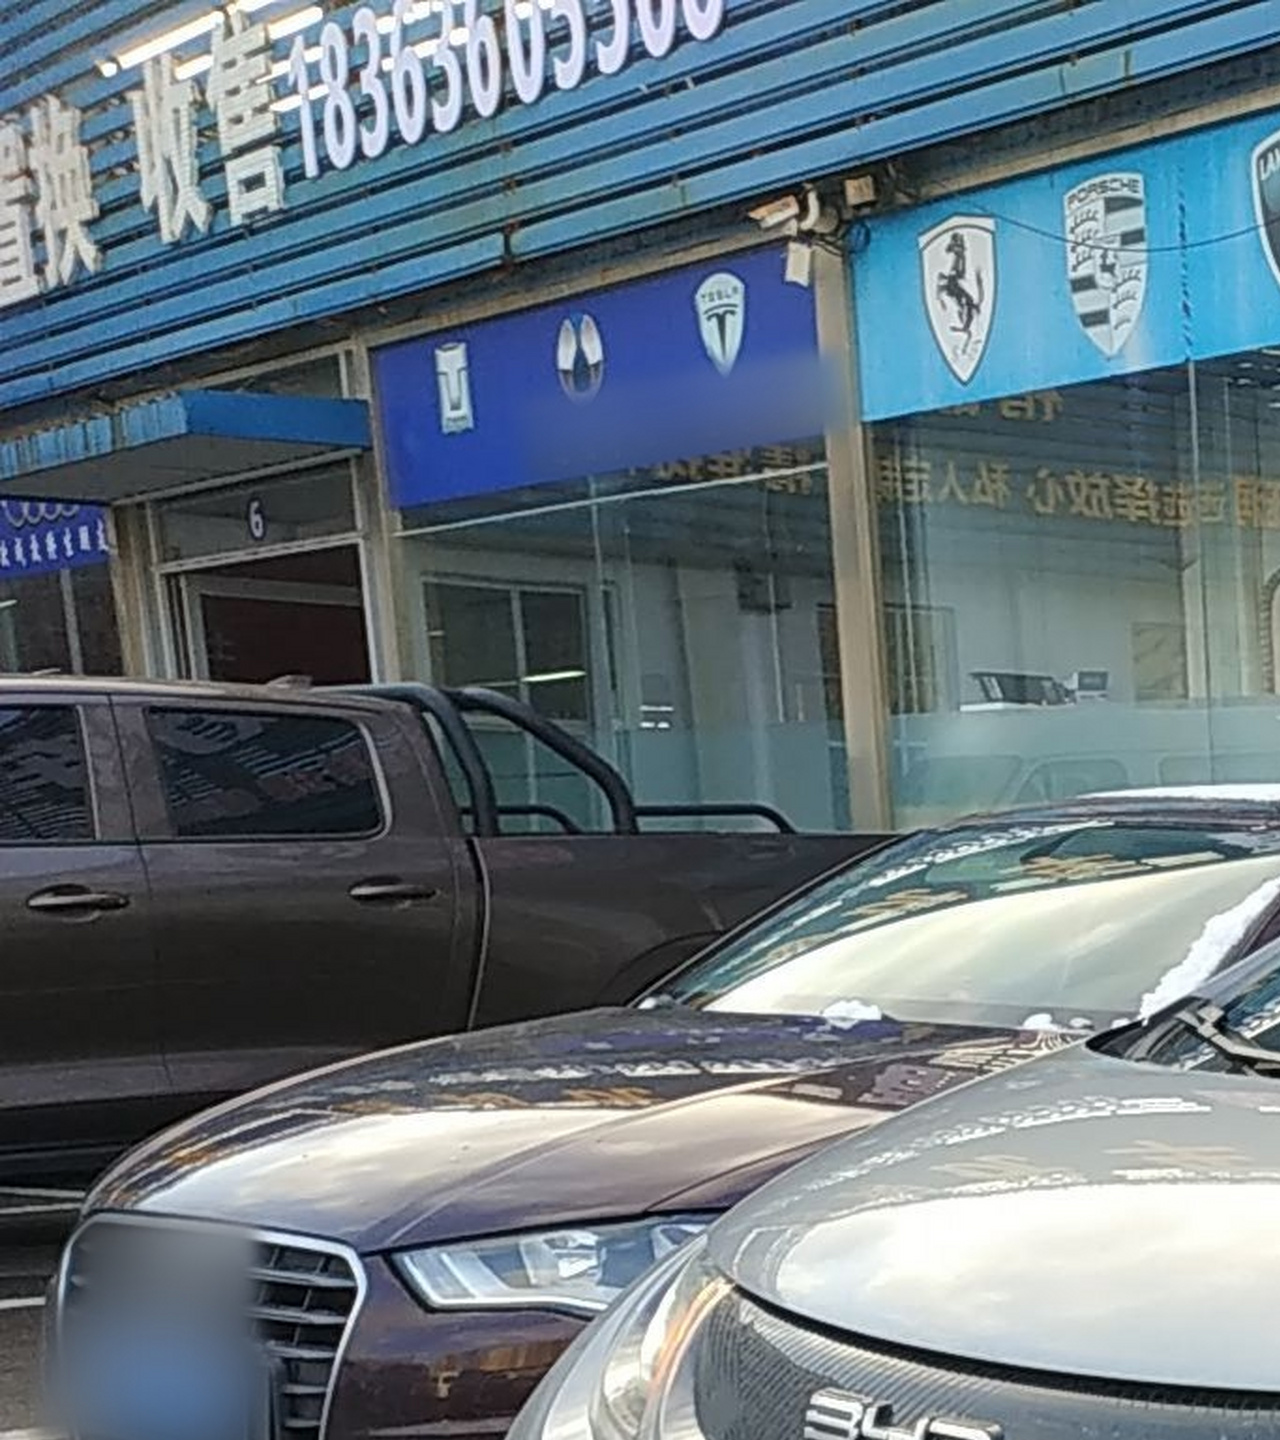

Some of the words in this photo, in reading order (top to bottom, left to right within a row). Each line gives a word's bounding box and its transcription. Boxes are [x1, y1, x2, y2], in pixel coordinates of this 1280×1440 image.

[1068, 176, 1141, 210] PORSCHE
[700, 285, 740, 303] TESLA
[249, 500, 267, 539] 6
